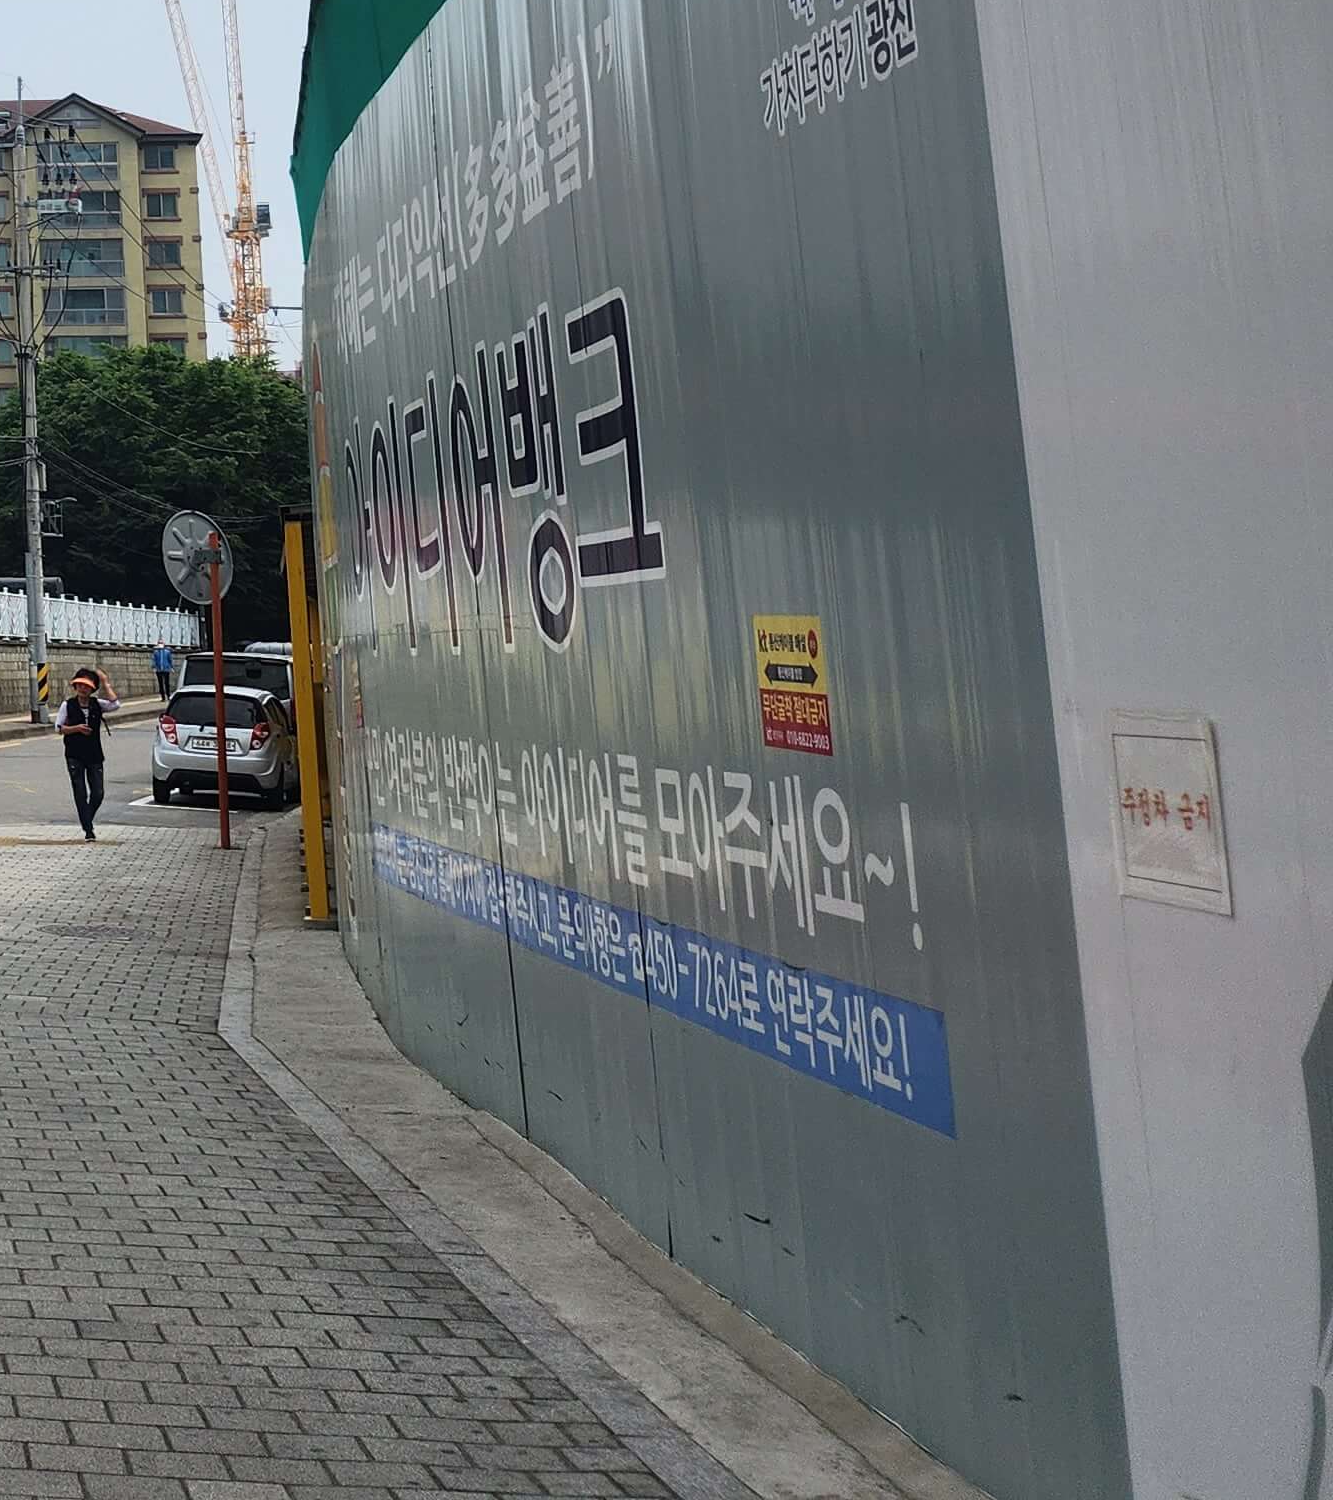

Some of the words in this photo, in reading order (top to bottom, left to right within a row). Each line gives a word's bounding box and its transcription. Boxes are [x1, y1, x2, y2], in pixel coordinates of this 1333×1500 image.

[760, 5, 865, 138] 가치더하기
[344, 284, 666, 656] 아이디어뱅크
[757, 628, 769, 653] kt
[793, 696, 829, 728] 절대금지
[440, 735, 519, 846] 반짝이는
[520, 745, 650, 888] 아이디어를
[1177, 792, 1211, 830] 금지
[559, 904, 628, 986] 문의사항은
[767, 972, 914, 1102] 연락주세요!
